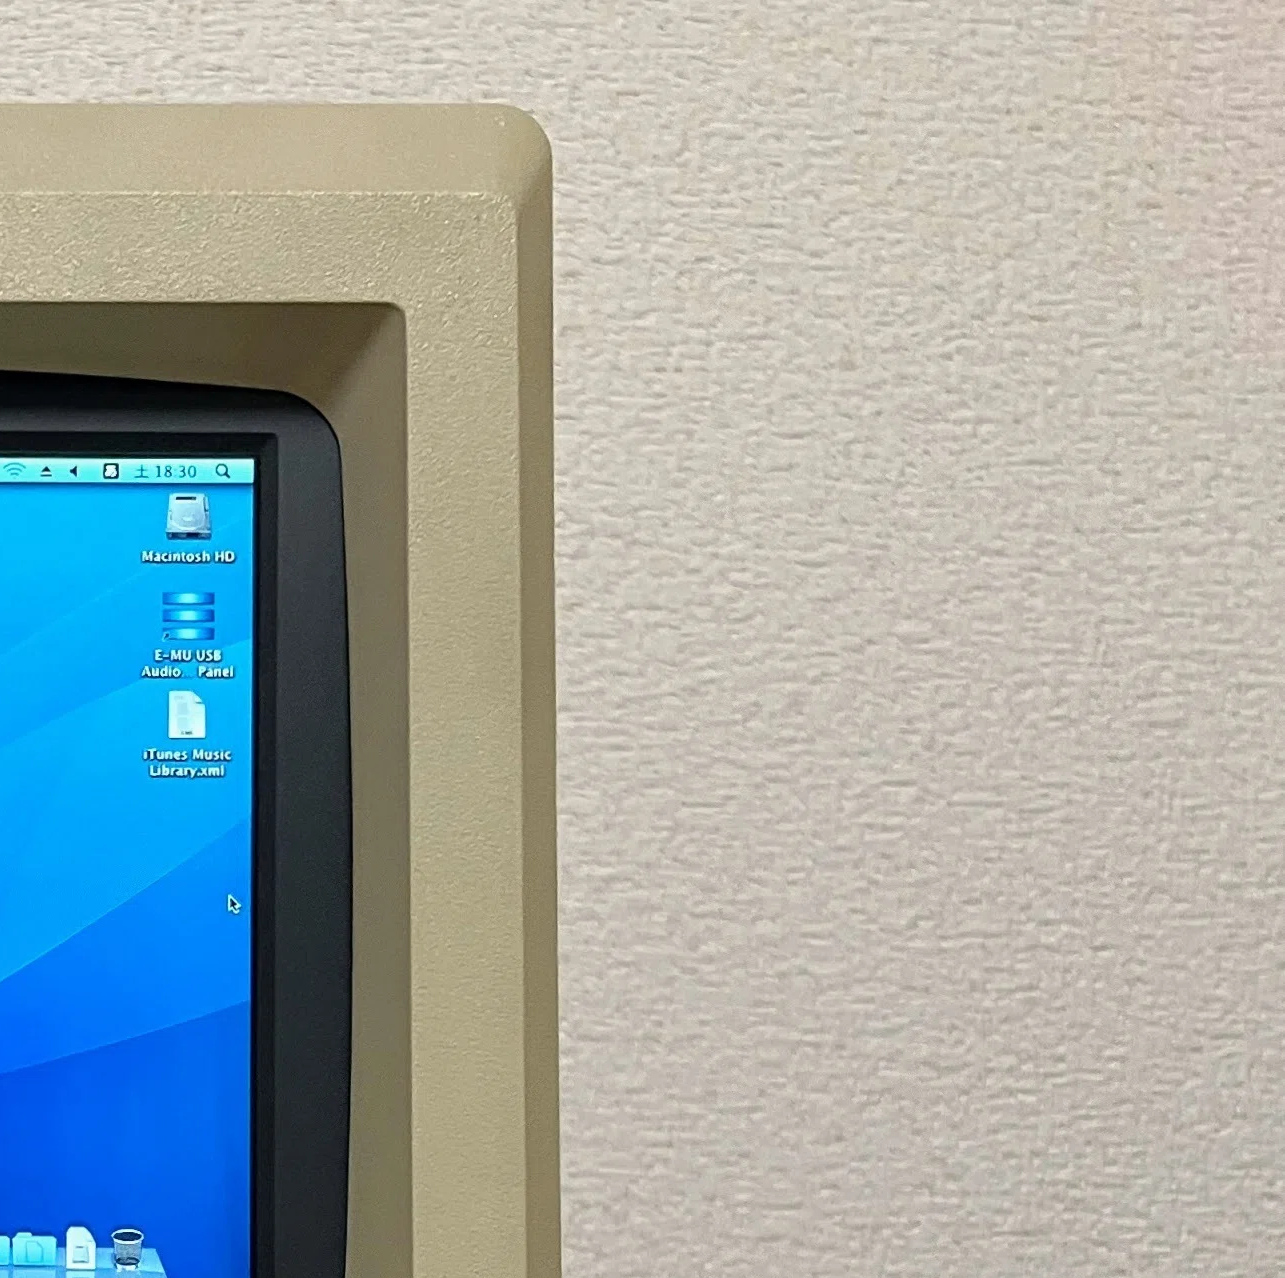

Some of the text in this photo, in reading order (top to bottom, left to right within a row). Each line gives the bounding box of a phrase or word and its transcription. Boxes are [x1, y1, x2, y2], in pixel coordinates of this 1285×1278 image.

[134, 466, 196, 478] 土 18:30
[141, 551, 235, 563] Macintosh HD
[155, 650, 222, 661] E-MU USB
[198, 666, 234, 678] Panel
[144, 749, 231, 760] iTunes Music
[150, 765, 224, 778] Library.xml
